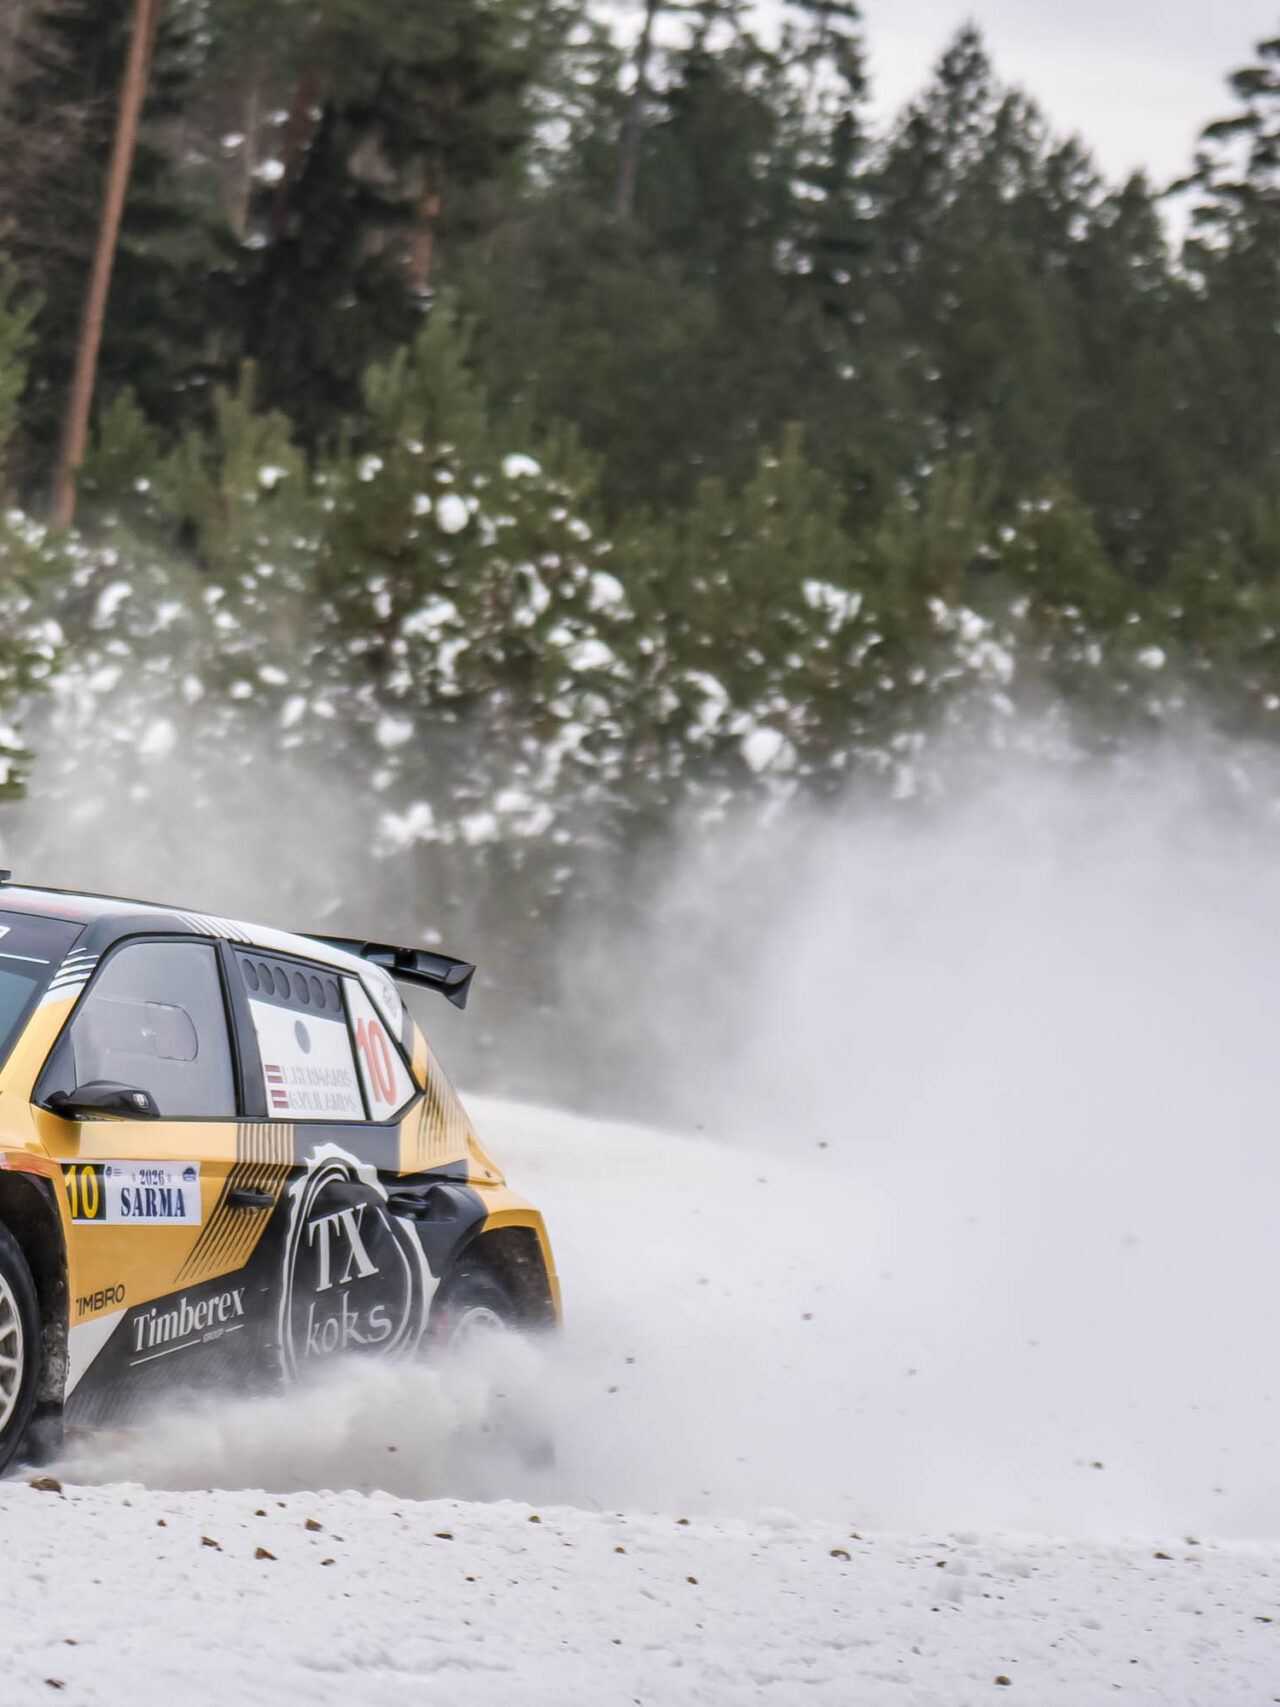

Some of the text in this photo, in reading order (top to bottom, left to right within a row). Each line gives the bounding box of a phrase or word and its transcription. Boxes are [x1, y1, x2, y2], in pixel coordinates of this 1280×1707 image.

[354, 1018, 397, 1106] 10
[64, 1165, 99, 1219] 10
[120, 1187, 187, 1218] SARMA
[139, 1169, 165, 1186] 2026
[309, 1202, 380, 1292] TX
[133, 1287, 246, 1352] Timberex
[304, 1290, 393, 1358] koks
